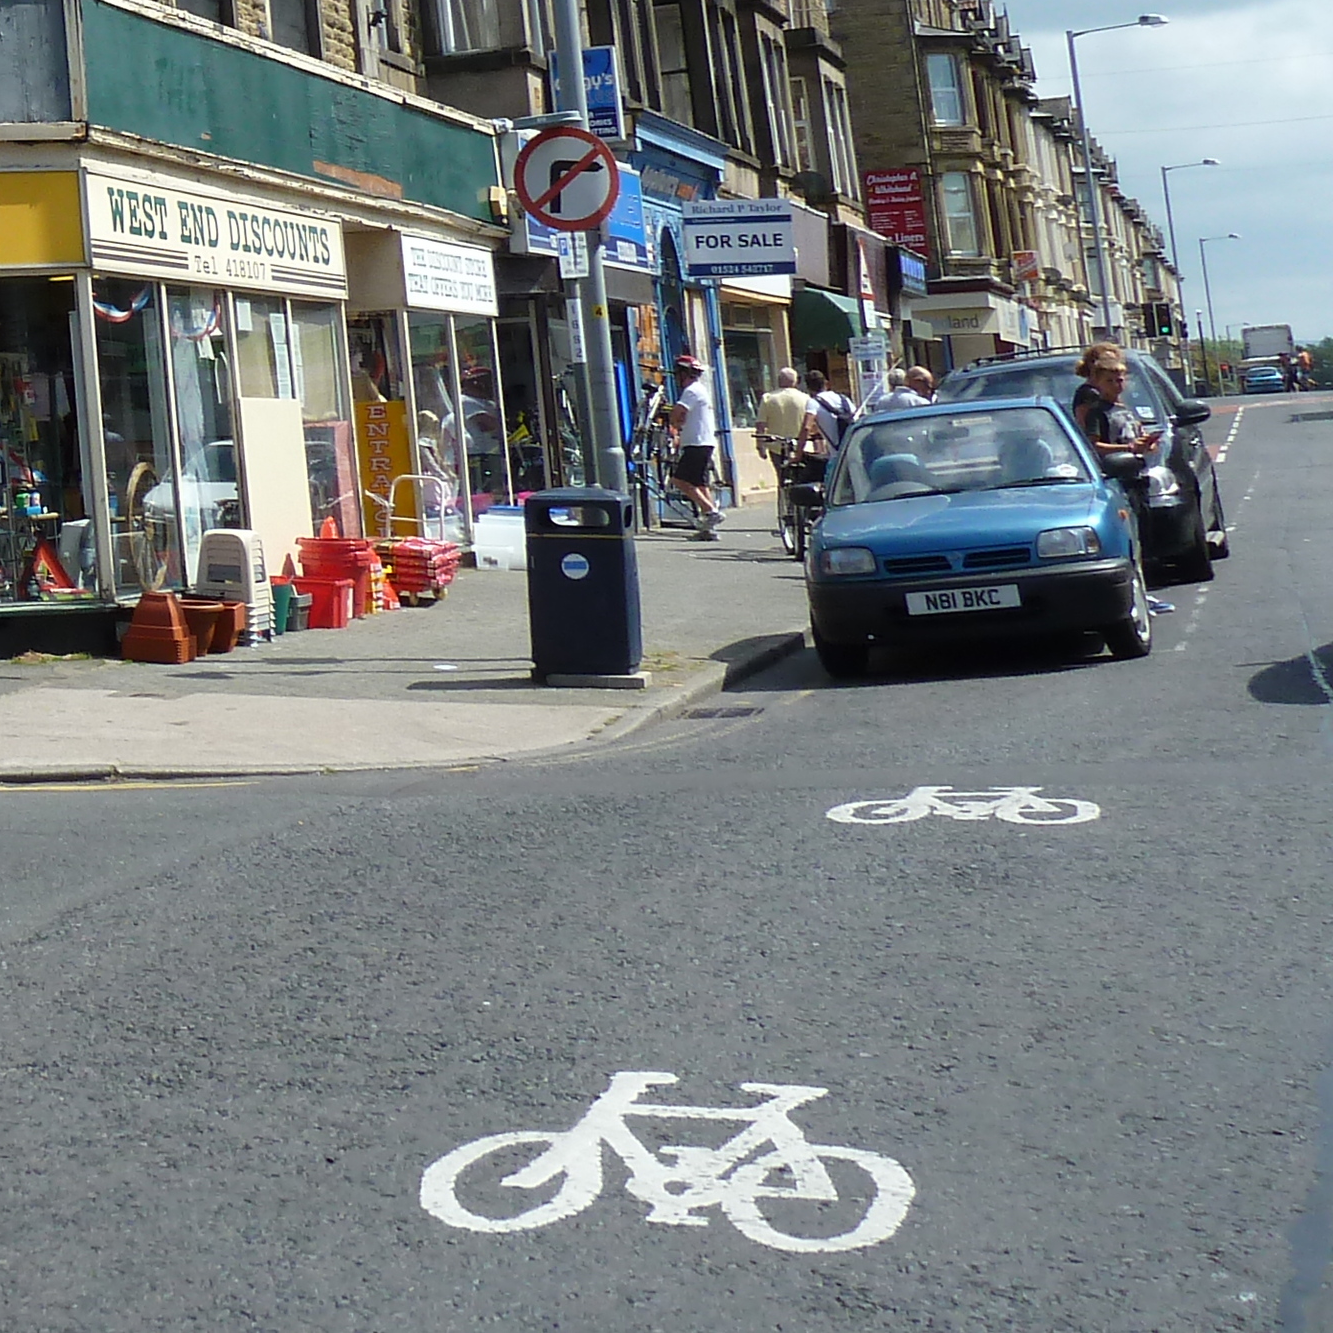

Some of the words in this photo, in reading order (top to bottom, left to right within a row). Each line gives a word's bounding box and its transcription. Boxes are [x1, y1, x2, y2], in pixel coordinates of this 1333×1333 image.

[692, 205, 734, 214] Richard
[749, 204, 782, 214] Taylor
[107, 187, 168, 240] WEST
[177, 201, 219, 248] END
[227, 209, 331, 266] DISCOUNTS
[695, 234, 733, 249] FOR
[738, 233, 783, 248] SALE
[194, 255, 219, 275] Tel
[226, 258, 266, 281] 418107
[924, 592, 958, 611] N81
[962, 589, 1001, 608] BKC
